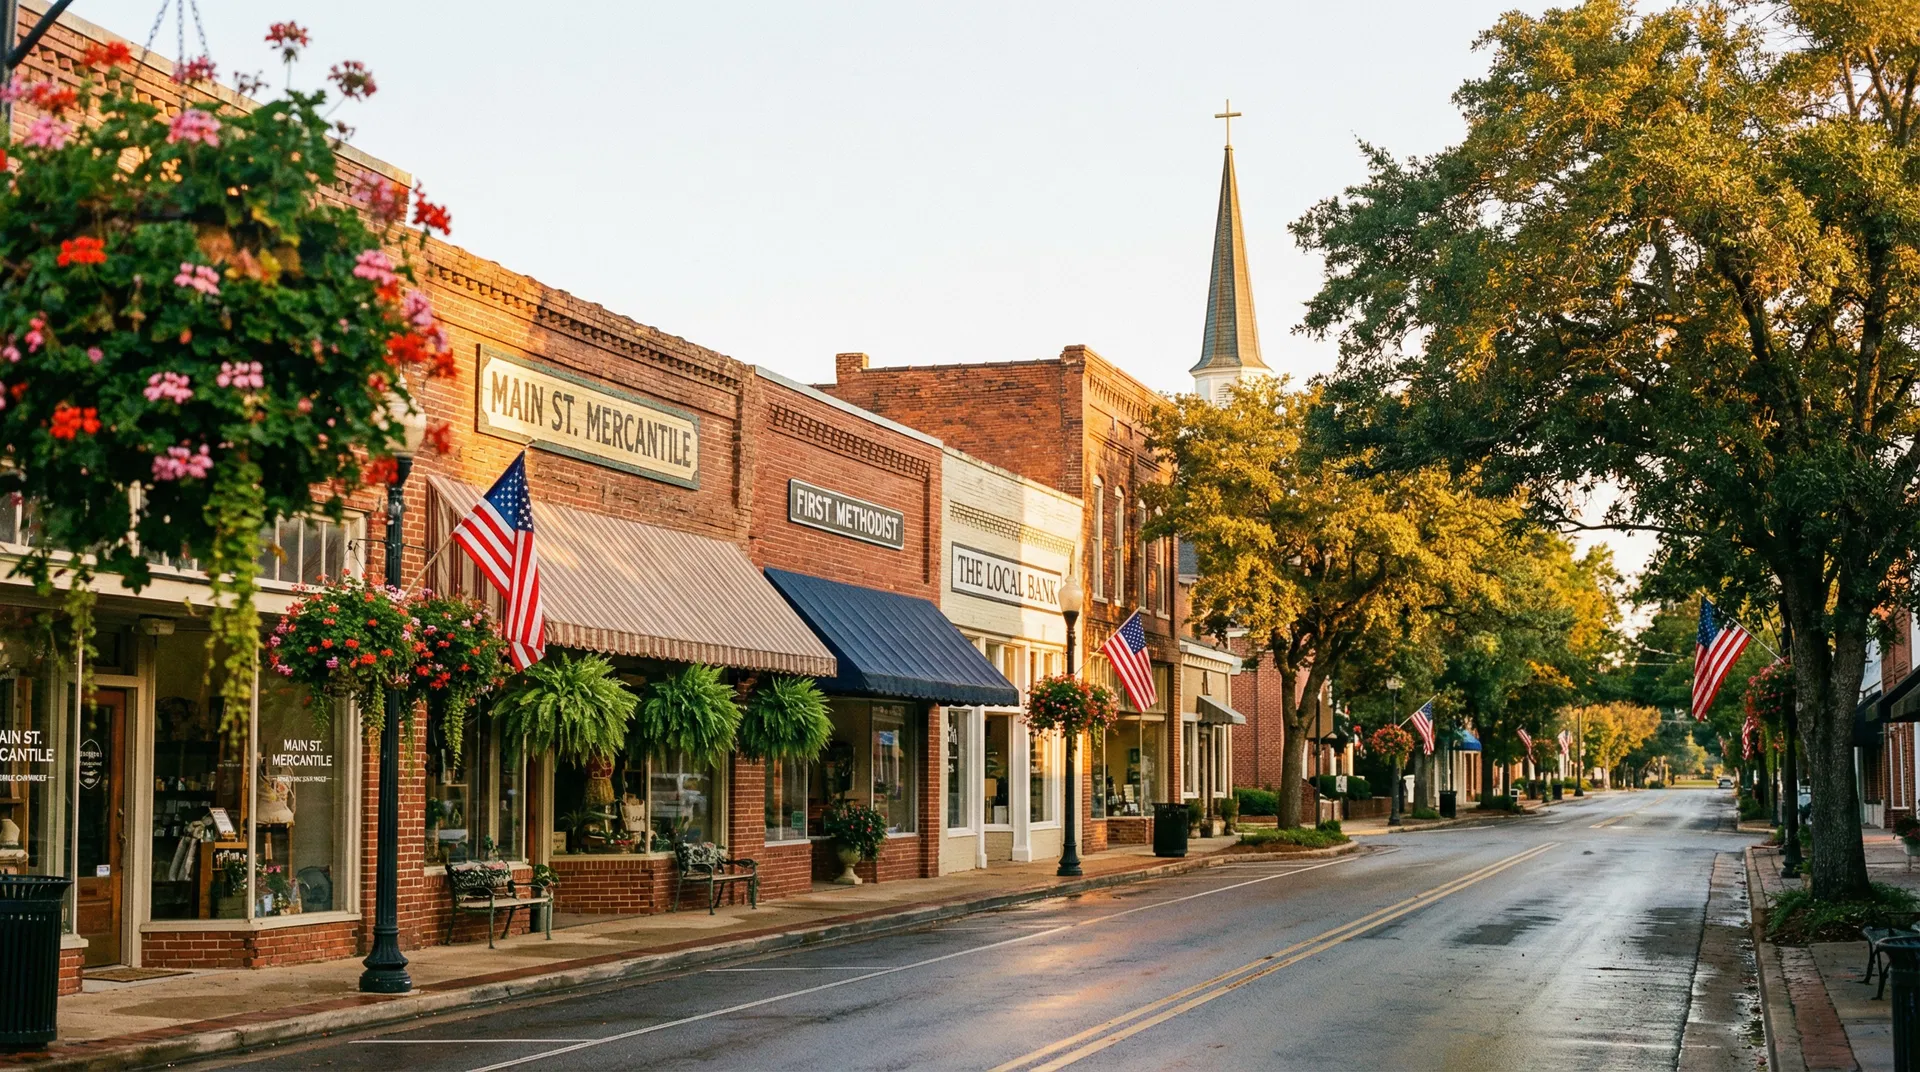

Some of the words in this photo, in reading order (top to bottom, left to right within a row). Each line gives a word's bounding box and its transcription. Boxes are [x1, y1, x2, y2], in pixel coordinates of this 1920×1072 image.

[491, 371, 544, 427] MAIN
[551, 390, 578, 436] ST.
[586, 401, 692, 468] MERCANTILE
[796, 488, 832, 522] FIRST
[836, 500, 899, 541] METHODIST
[958, 554, 983, 588] THE
[986, 562, 1025, 598] LOCAL
[1027, 574, 1057, 605] BANK
[0, 729, 21, 745] AIN
[23, 730, 42, 745] ST.
[283, 739, 308, 752] MAIN
[309, 740, 323, 752] ST.
[0, 747, 55, 762] CANTILE
[272, 753, 333, 767] MERCANTILE
